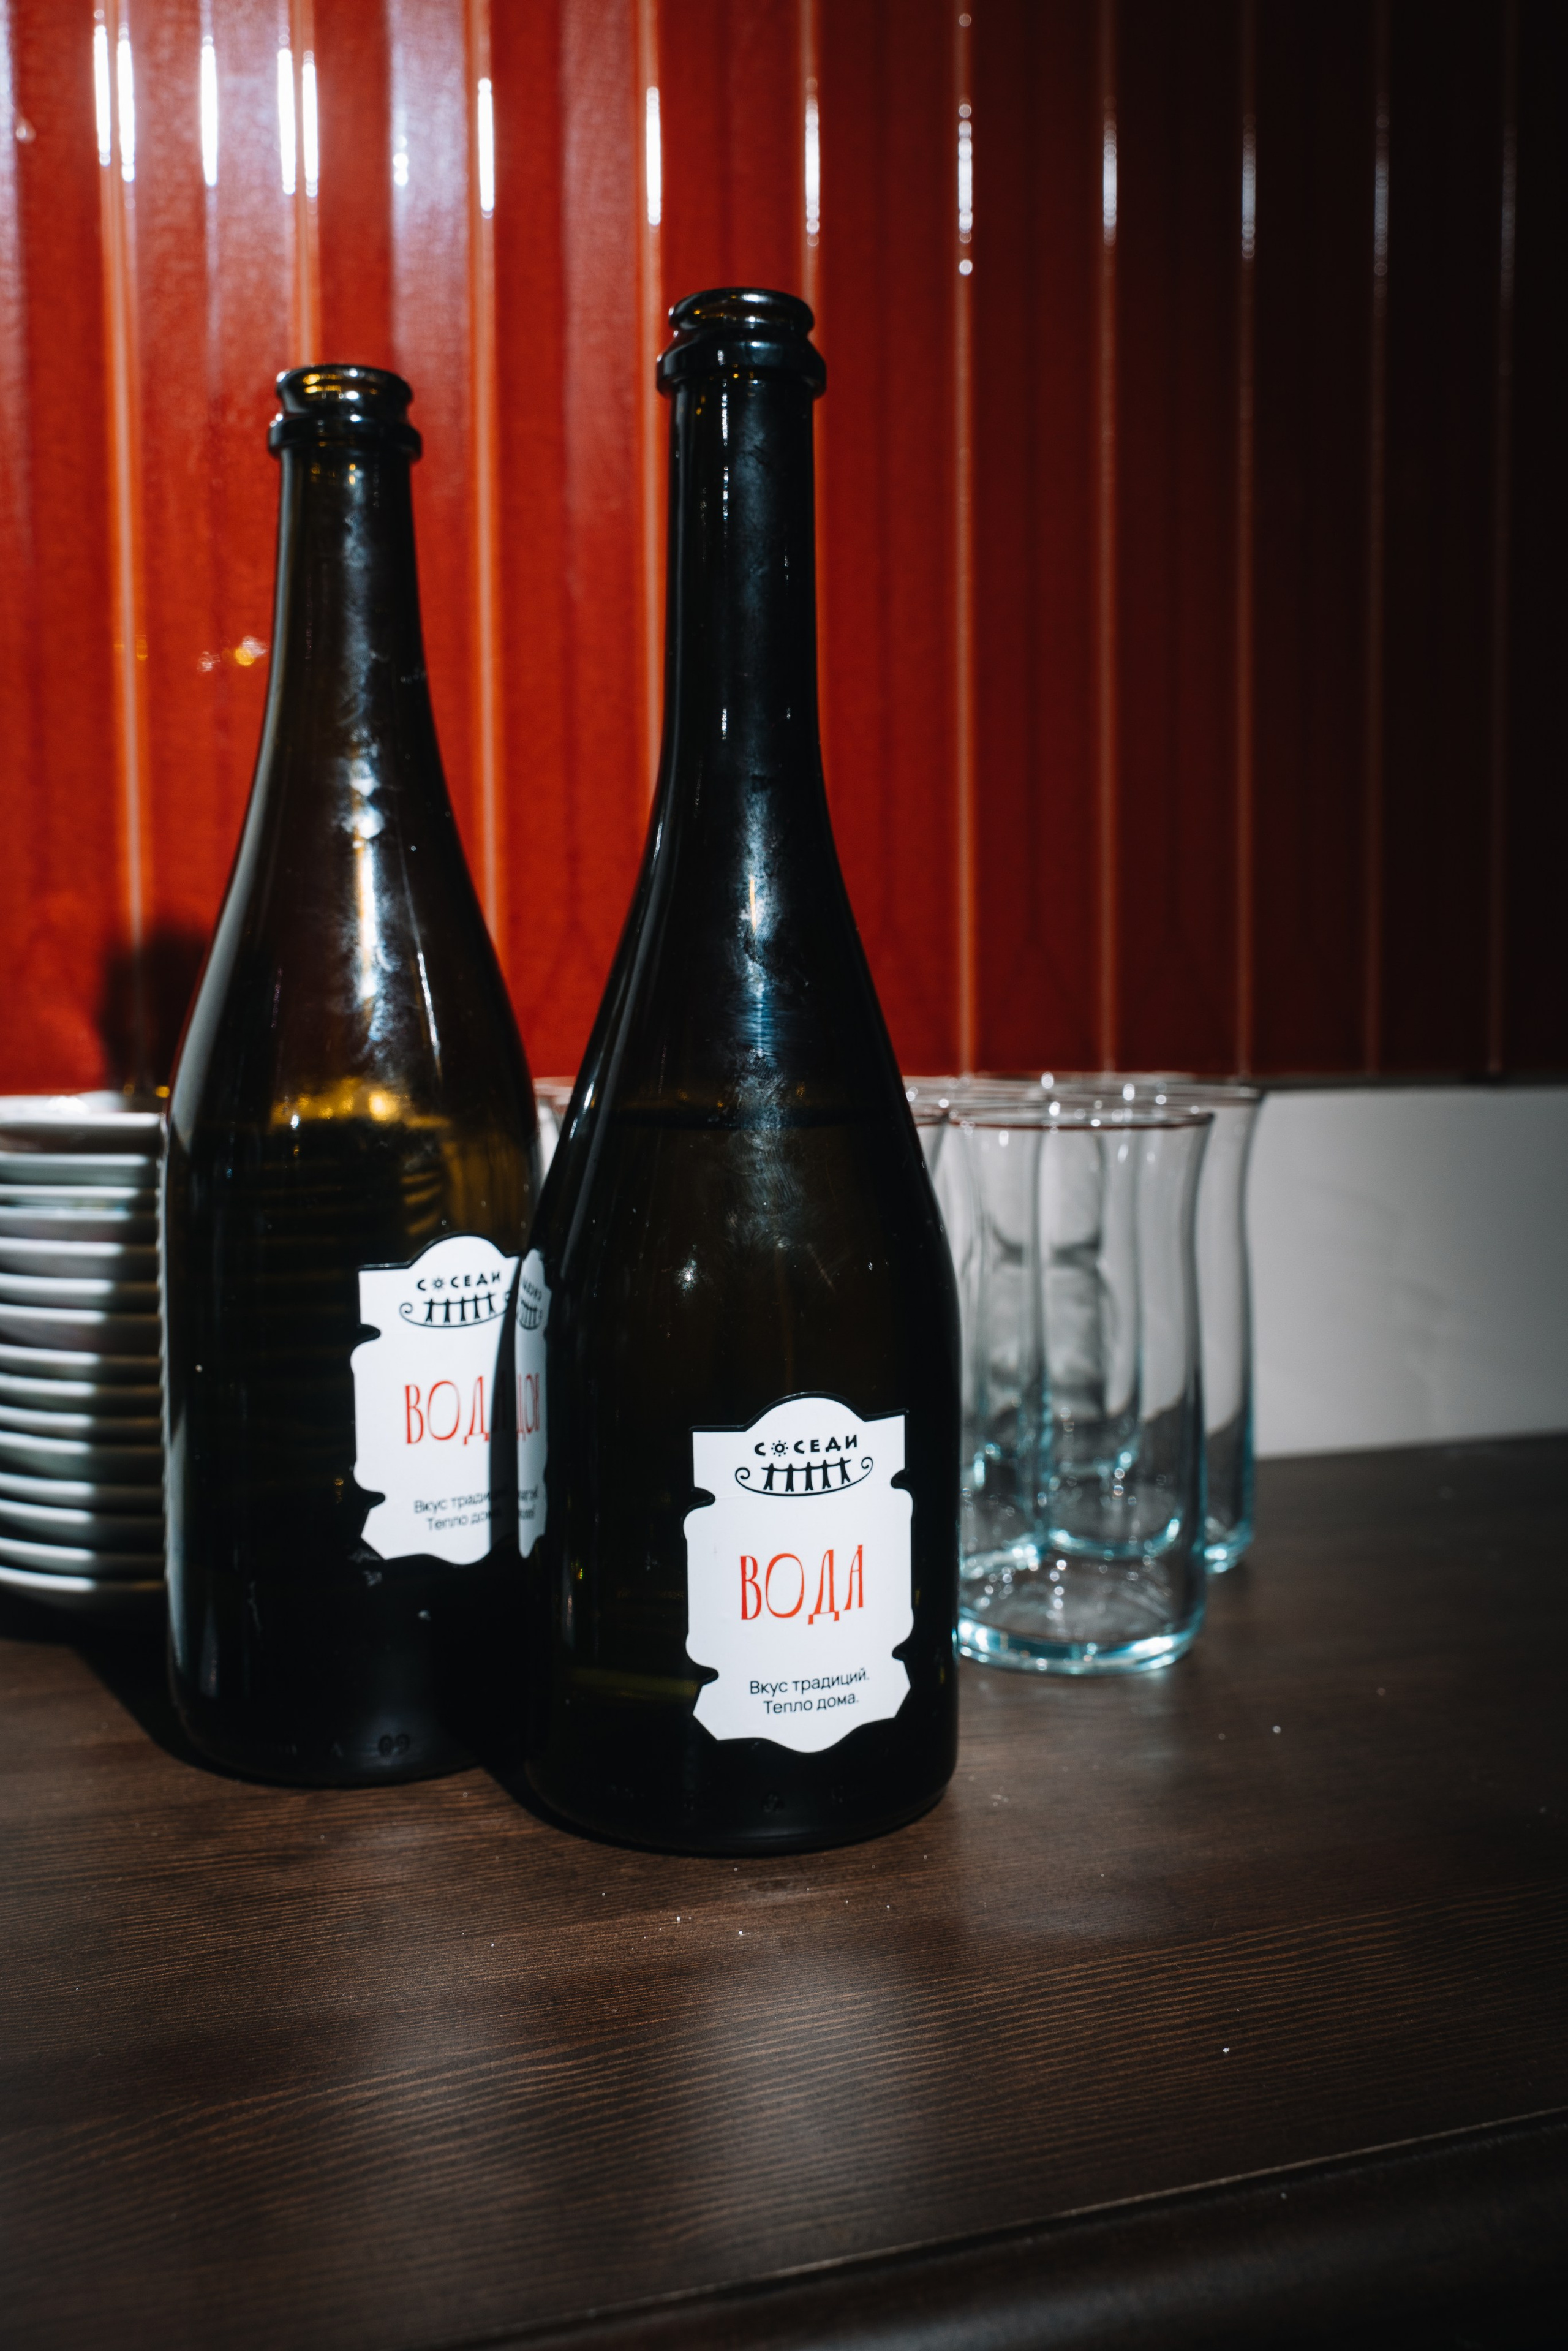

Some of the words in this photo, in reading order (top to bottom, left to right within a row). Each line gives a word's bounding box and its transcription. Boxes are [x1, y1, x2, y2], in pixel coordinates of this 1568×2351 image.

[417, 1270, 500, 1291] СОСЕДИ
[754, 1435, 857, 1457] СОСЕДИ
[413, 1499, 447, 1514] Вкус
[426, 1515, 469, 1531] Тепло
[740, 1545, 864, 1625] ВОДА
[750, 1681, 788, 1697] Вкус
[793, 1667, 869, 1694] традиций.
[763, 1700, 813, 1714] Тепло
[817, 1693, 859, 1711] дома.
